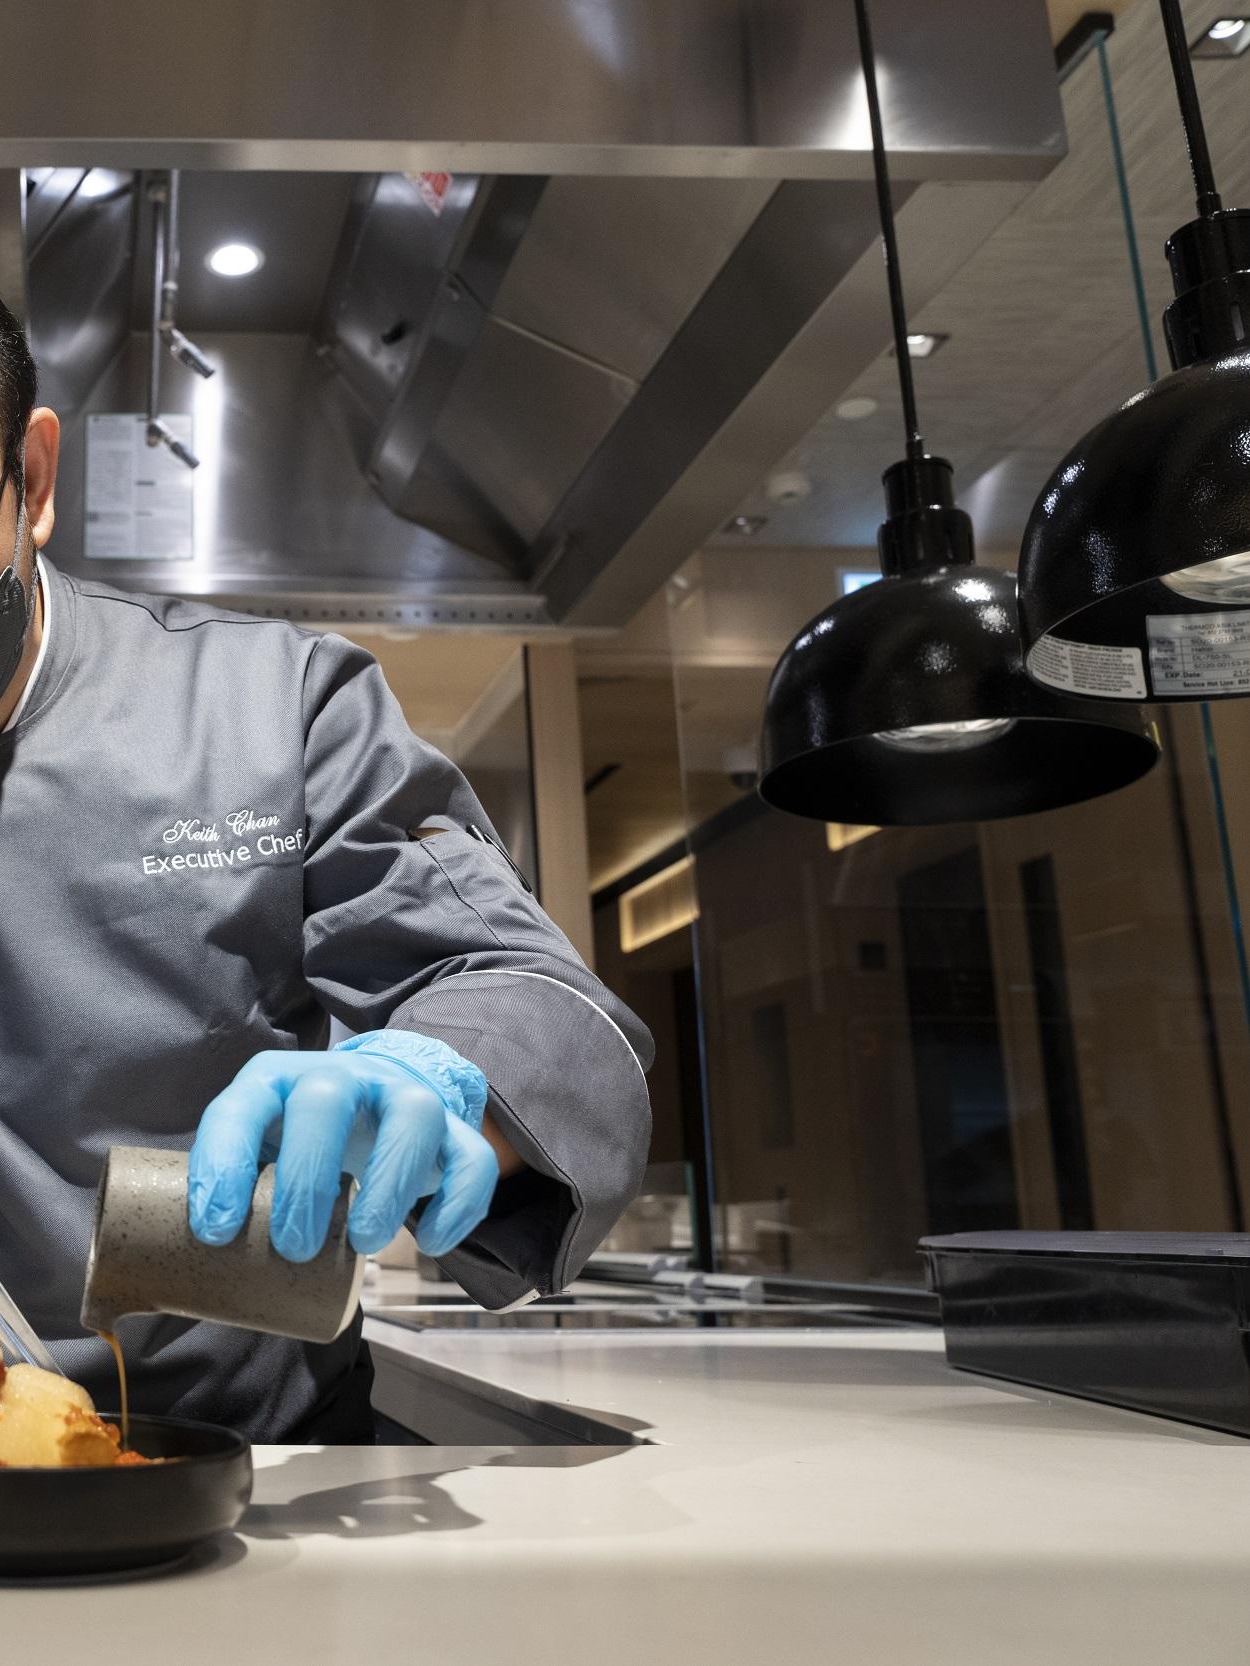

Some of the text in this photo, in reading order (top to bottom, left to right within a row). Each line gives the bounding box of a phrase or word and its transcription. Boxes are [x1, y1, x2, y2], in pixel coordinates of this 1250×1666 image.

[162, 809, 281, 844] Keith Chan
[141, 828, 303, 875] Executive Chef
